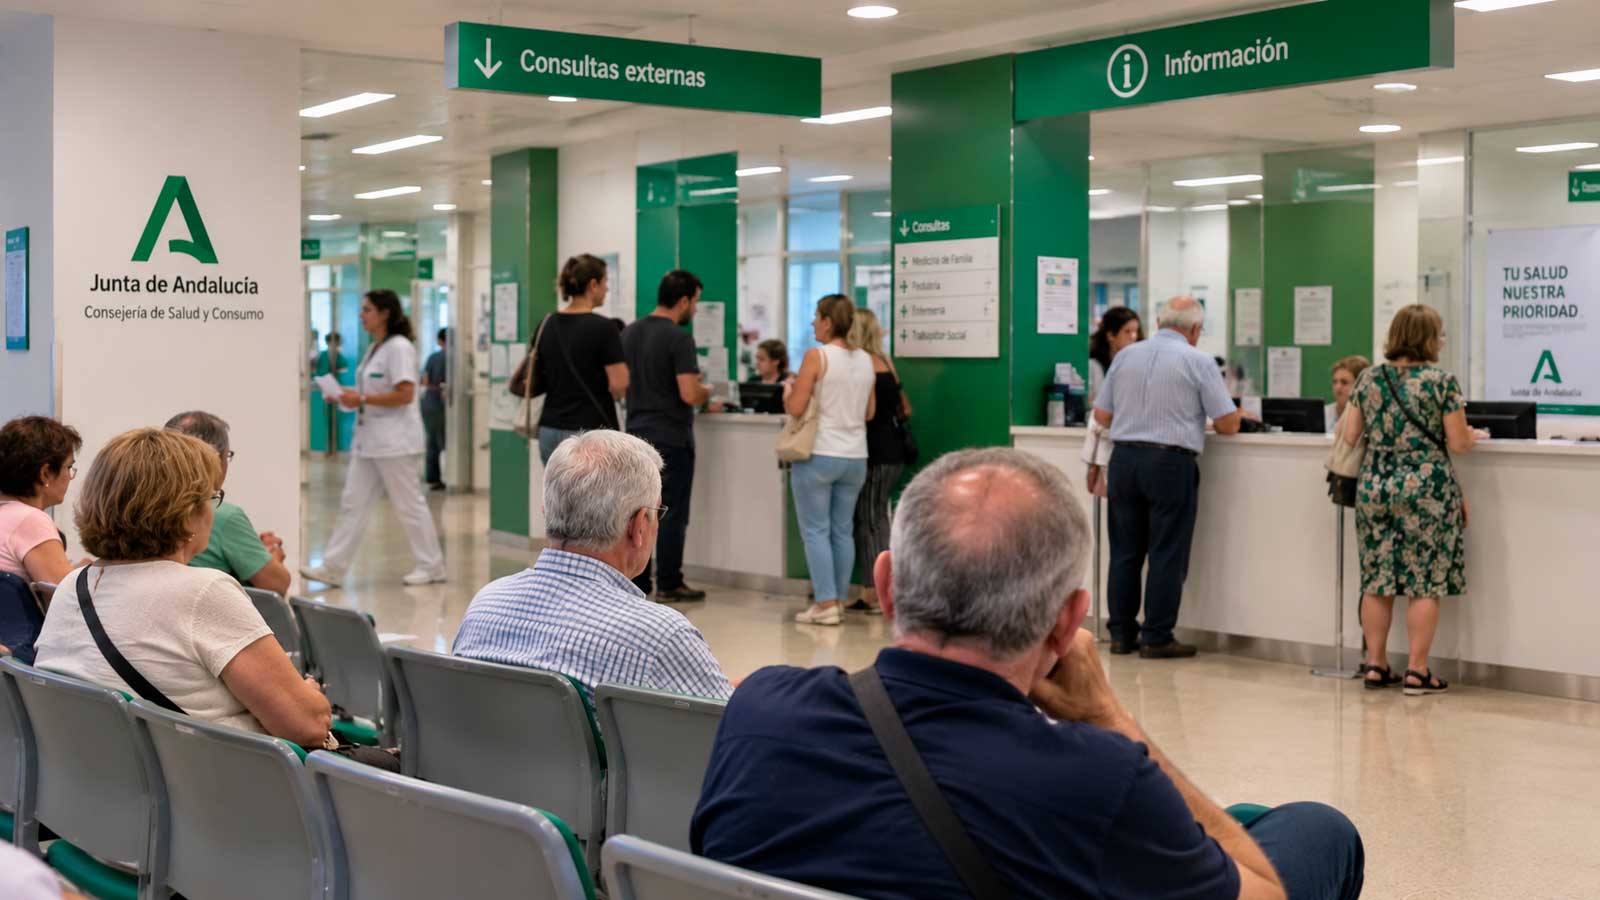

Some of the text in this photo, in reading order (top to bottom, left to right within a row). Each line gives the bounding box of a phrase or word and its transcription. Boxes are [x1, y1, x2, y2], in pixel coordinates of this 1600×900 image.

[1165, 36, 1289, 77] Información
[520, 48, 706, 88] Consultas externas
[912, 219, 951, 234] Consultas
[1502, 265, 1568, 281] TU SALUD
[90, 273, 259, 294] Junta de Andalucía
[1503, 285, 1566, 300] NUESTRA
[84, 305, 265, 322] Consejería de Salud y Consumo
